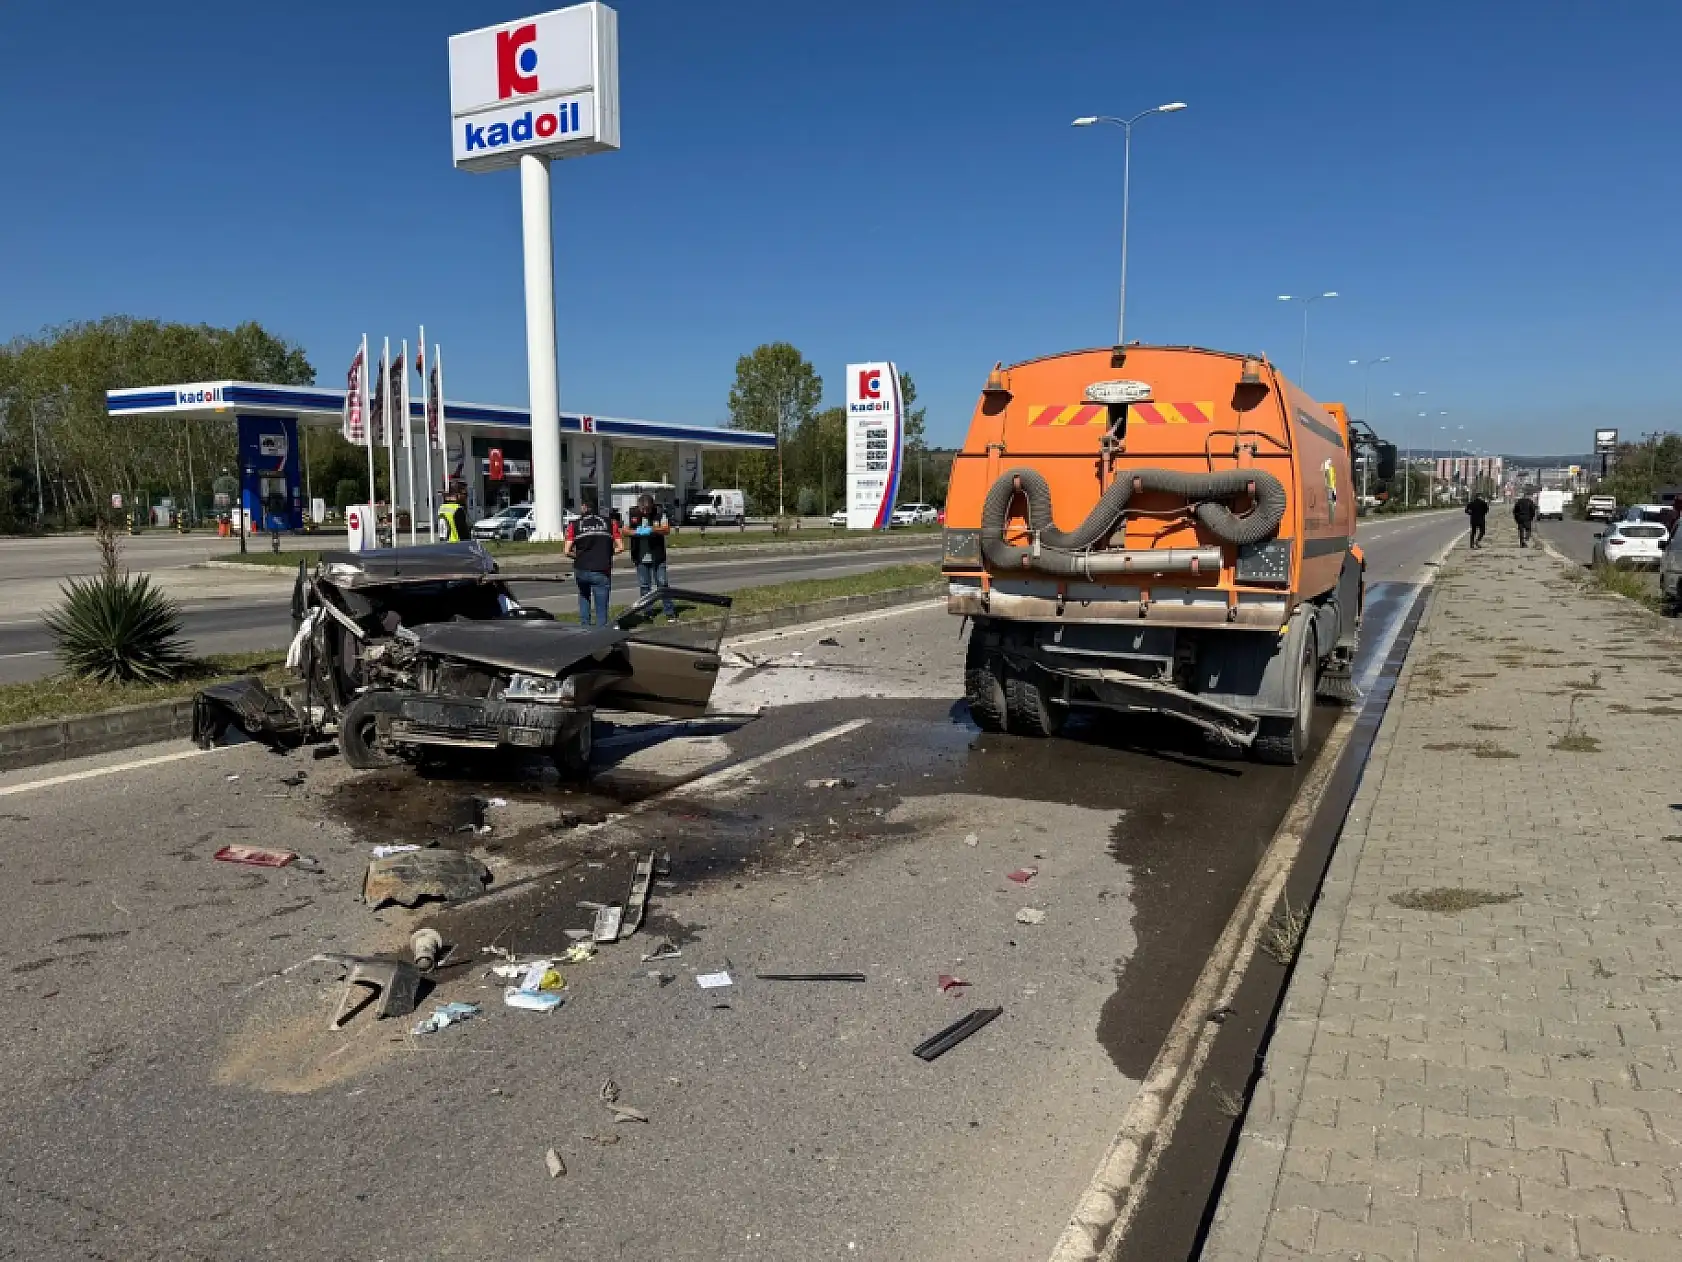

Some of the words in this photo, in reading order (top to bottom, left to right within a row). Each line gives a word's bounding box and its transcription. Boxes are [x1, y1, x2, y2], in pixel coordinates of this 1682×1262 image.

[465, 102, 579, 151] kadoil
[179, 388, 219, 403] kadoil
[850, 400, 889, 412] kadoil
